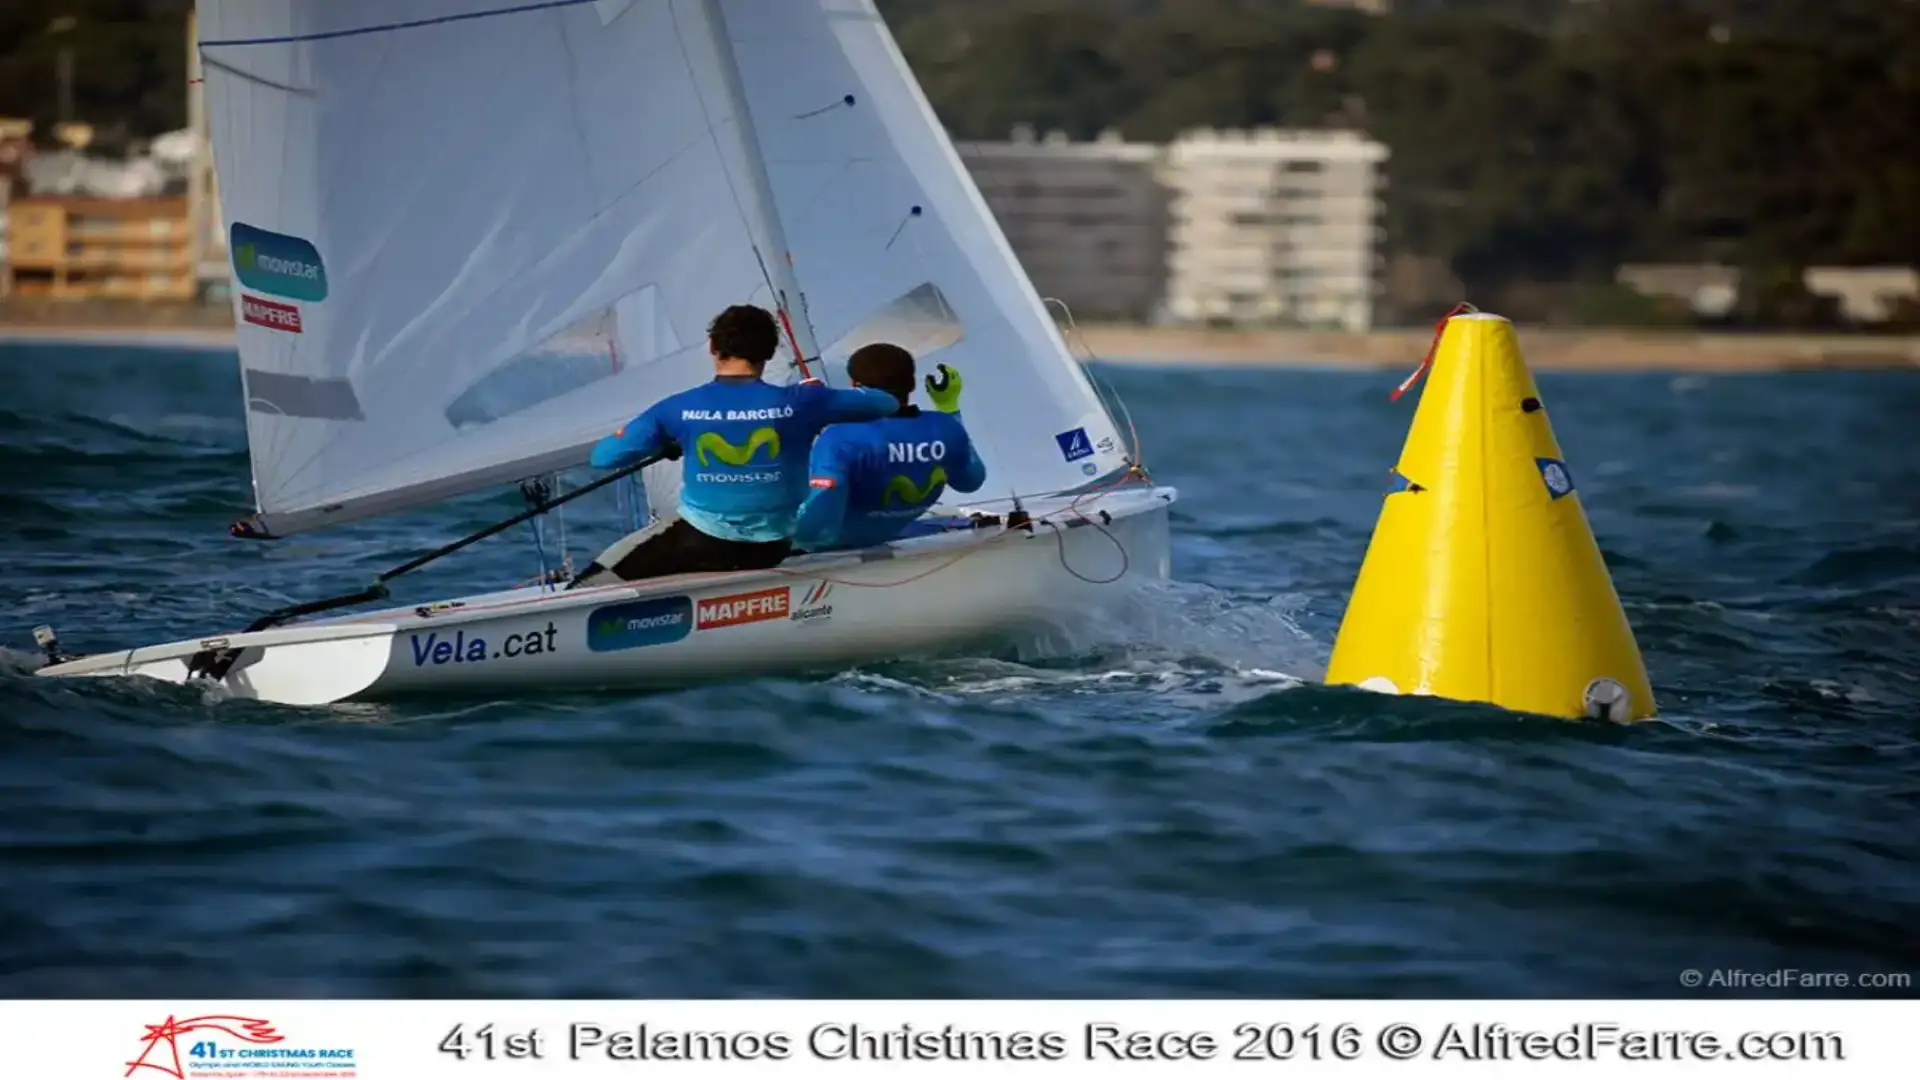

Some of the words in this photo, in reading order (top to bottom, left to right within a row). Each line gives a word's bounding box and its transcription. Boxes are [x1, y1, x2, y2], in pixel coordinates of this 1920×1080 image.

[257, 254, 318, 280] movistar
[243, 302, 300, 326] MAPFRE
[682, 408, 723, 421] PAULA
[726, 403, 794, 420] BARCELÓ
[888, 440, 946, 463] NICO
[696, 472, 783, 483] movistar
[700, 593, 788, 622] MAPFRE
[627, 612, 685, 631] movistar
